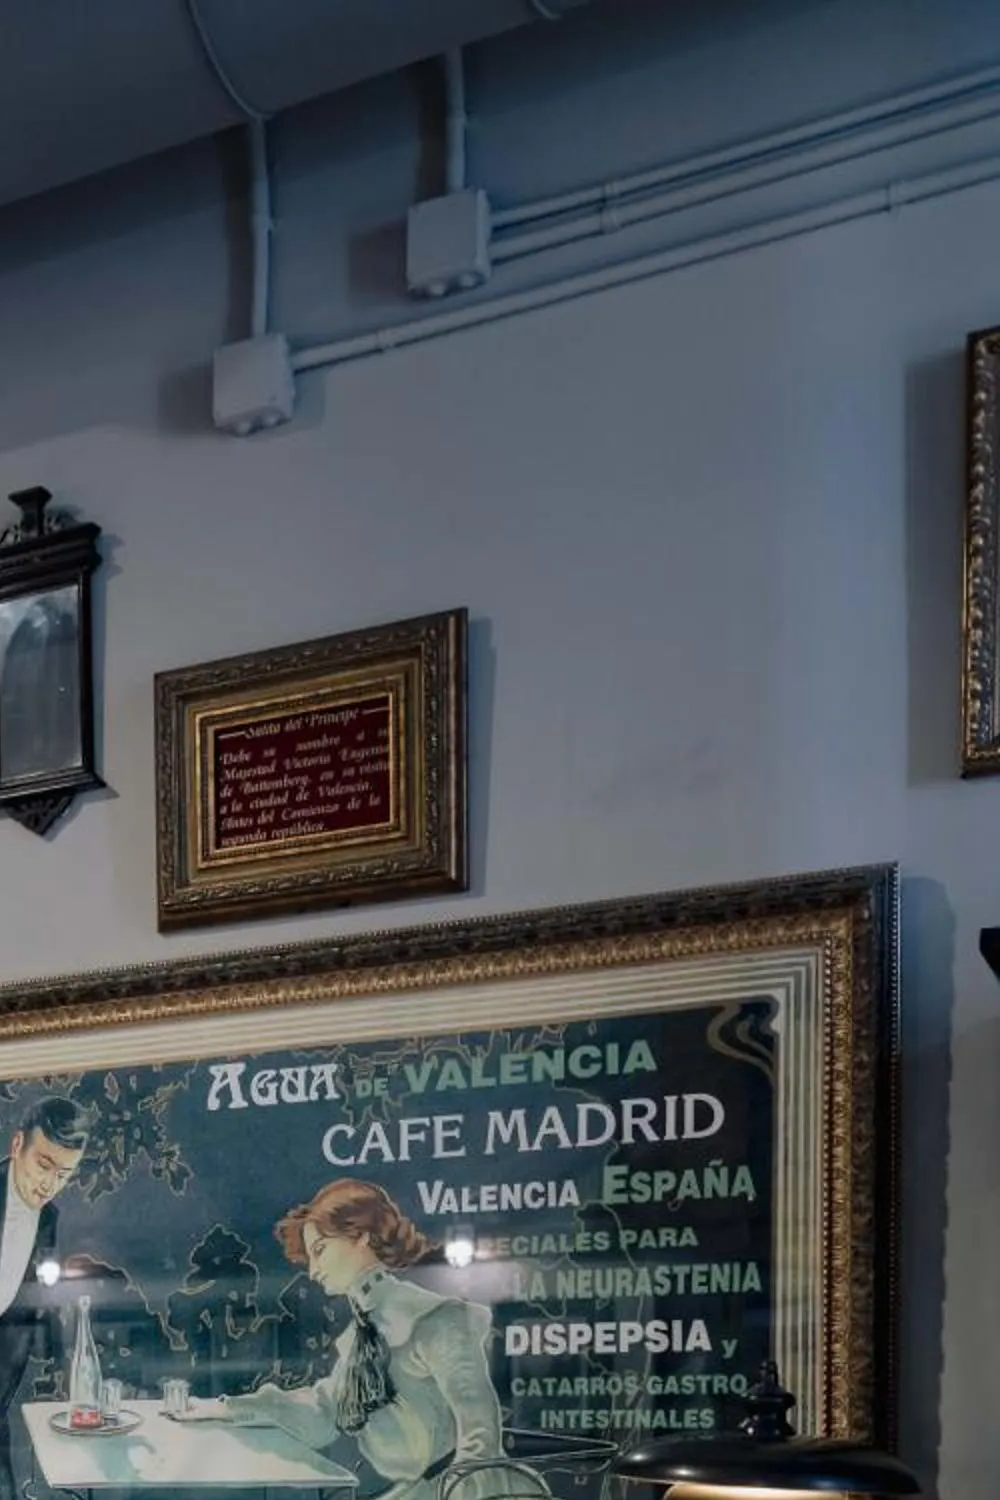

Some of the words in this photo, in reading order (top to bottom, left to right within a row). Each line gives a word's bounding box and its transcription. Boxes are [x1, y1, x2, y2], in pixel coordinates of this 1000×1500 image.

[285, 714, 302, 732] del
[219, 749, 252, 765] Debe
[295, 733, 341, 752] nombre
[219, 761, 276, 783] Majestad
[282, 753, 331, 770] Victoria
[219, 784, 233, 799] de
[249, 789, 289, 810] ciudad
[295, 788, 310, 803] de
[353, 1075, 389, 1099] DE
[402, 1038, 658, 1097] VALENCIA
[321, 1113, 467, 1168] CAFE
[484, 1092, 726, 1156] MADRID
[416, 1179, 580, 1215] VALENCIA
[602, 1157, 757, 1205] ESPAÑA
[621, 1225, 699, 1250] PARA
[513, 1269, 547, 1302] LA
[556, 1260, 762, 1301] NEURASTENIA
[504, 1318, 713, 1358] DISPEPSIA
[510, 1376, 638, 1399] CATARROS
[645, 1373, 749, 1398] GASTRO
[540, 1407, 715, 1431] INTESTINALES
